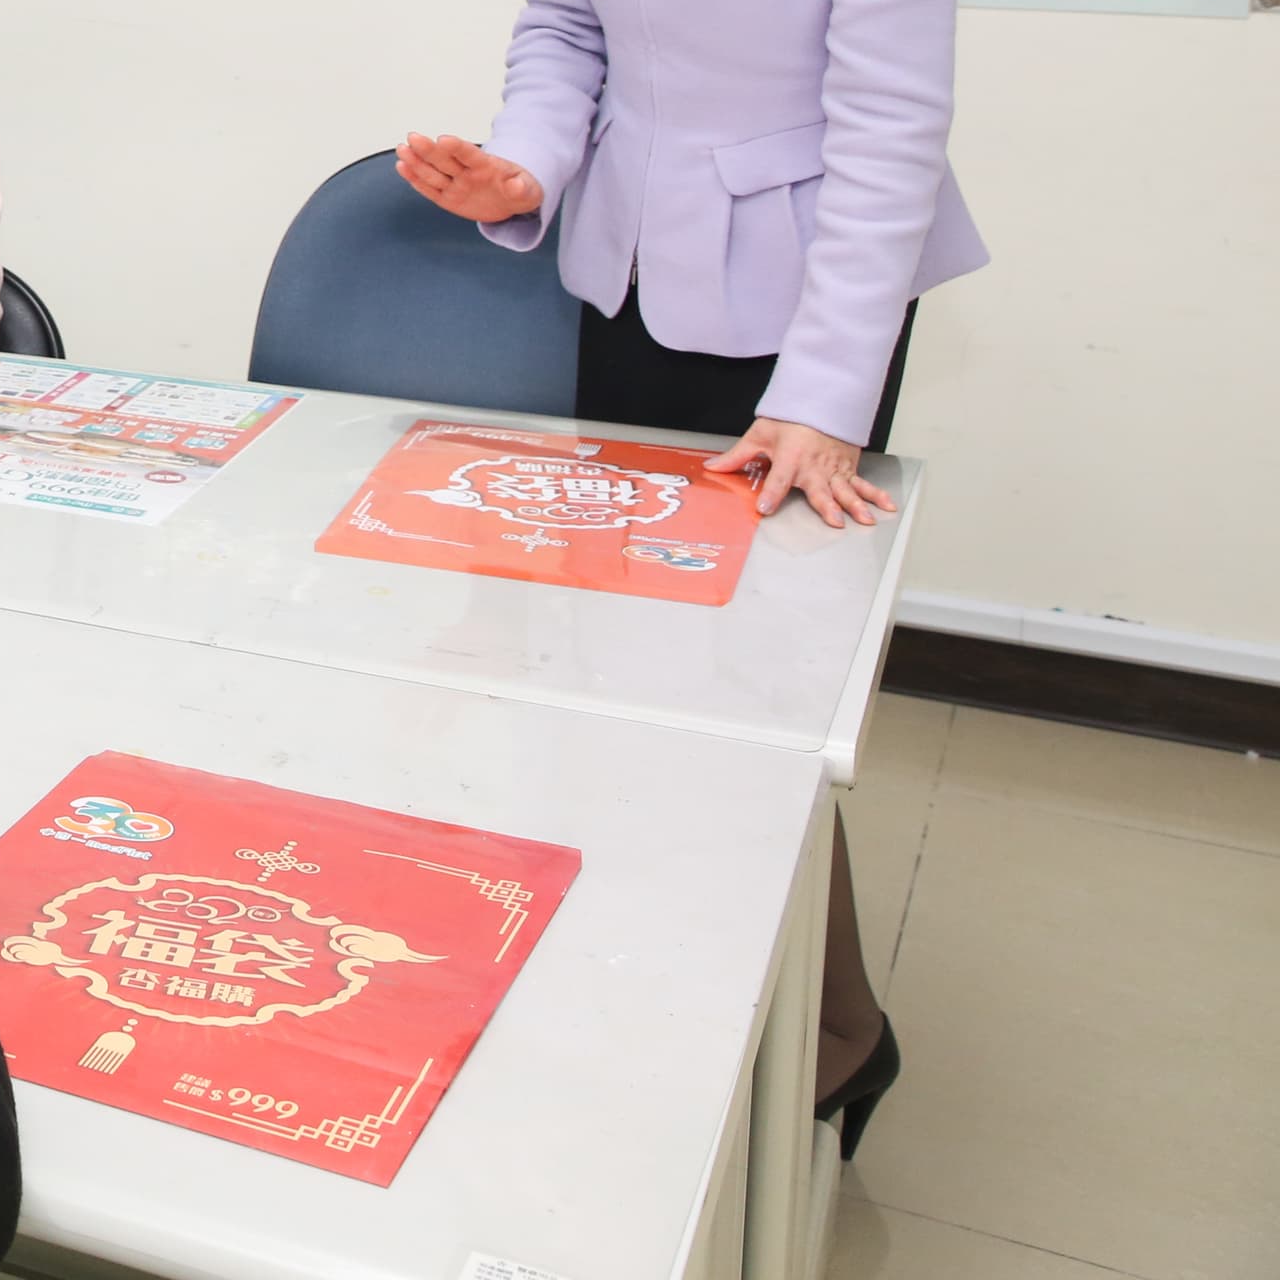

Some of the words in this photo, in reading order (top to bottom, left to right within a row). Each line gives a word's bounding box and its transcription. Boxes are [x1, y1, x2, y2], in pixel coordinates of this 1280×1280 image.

[81, 909, 315, 989] 福袋
[119, 967, 257, 1008] 杏福購
